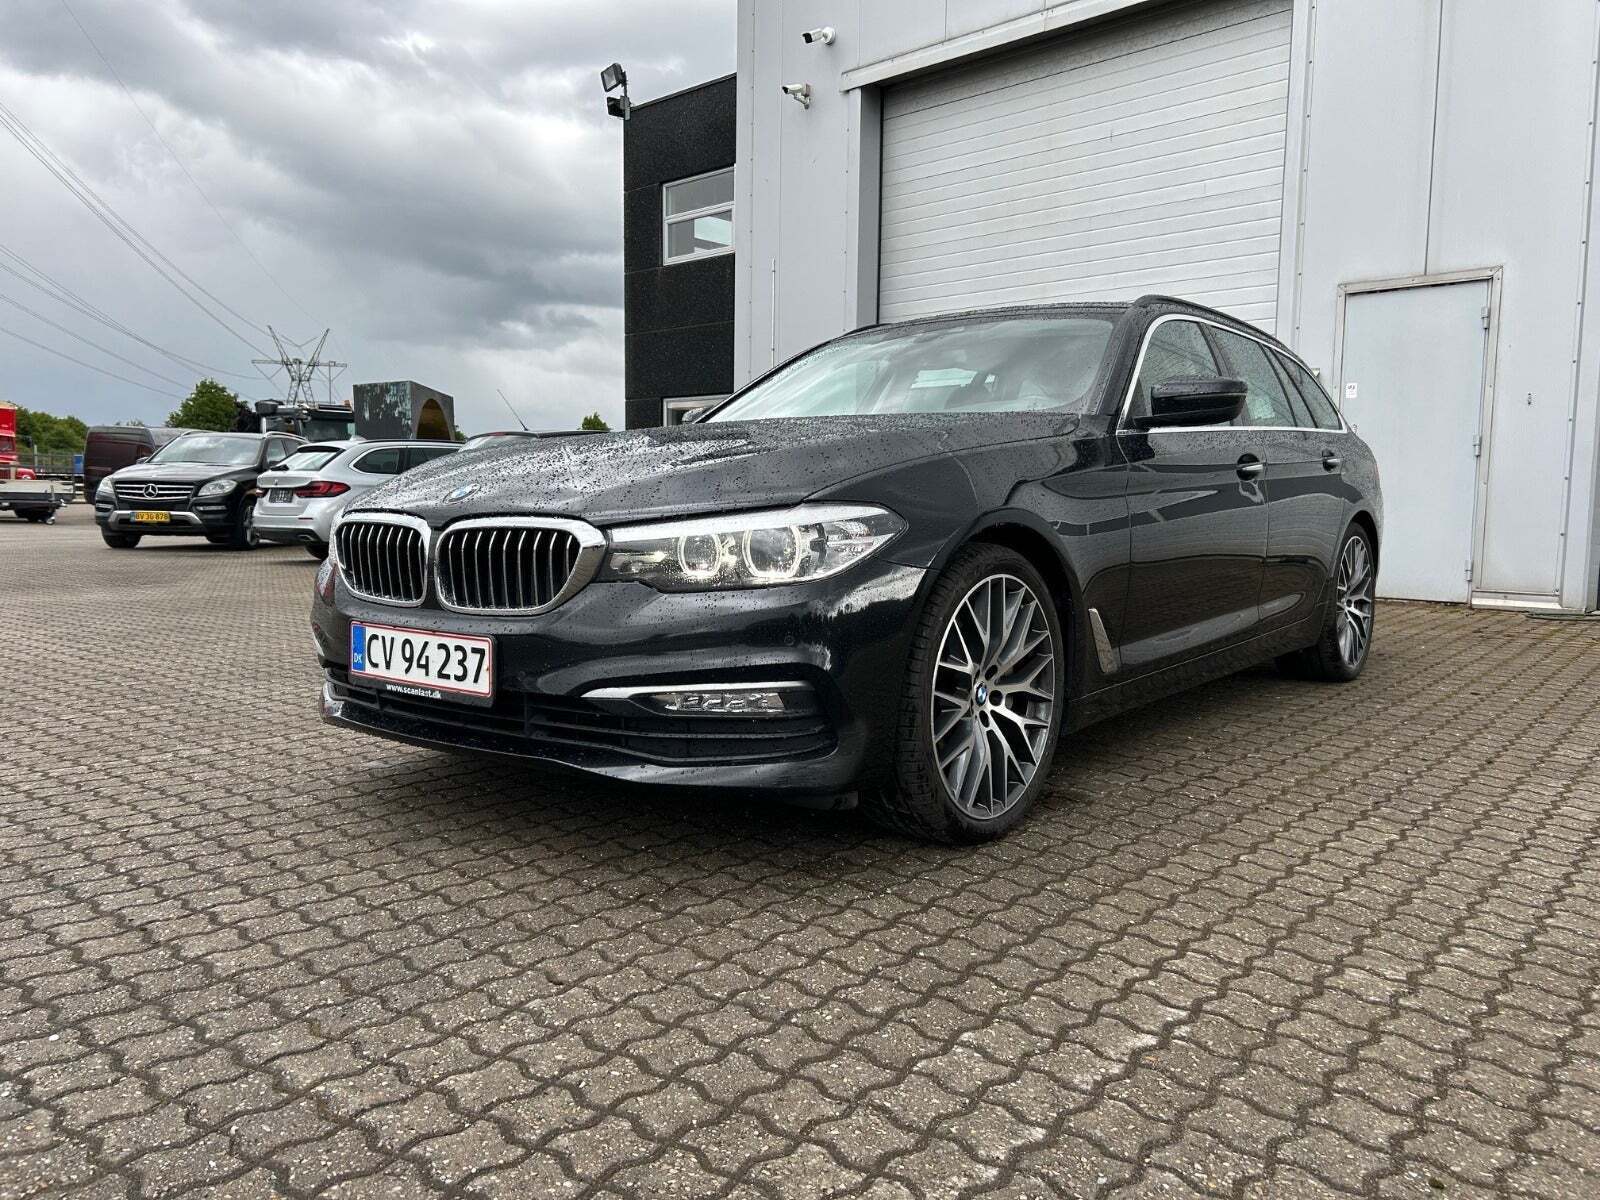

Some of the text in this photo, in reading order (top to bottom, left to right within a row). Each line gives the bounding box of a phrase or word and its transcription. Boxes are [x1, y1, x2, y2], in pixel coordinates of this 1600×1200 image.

[353, 652, 363, 664] DK
[366, 633, 486, 684] CV 94 237
